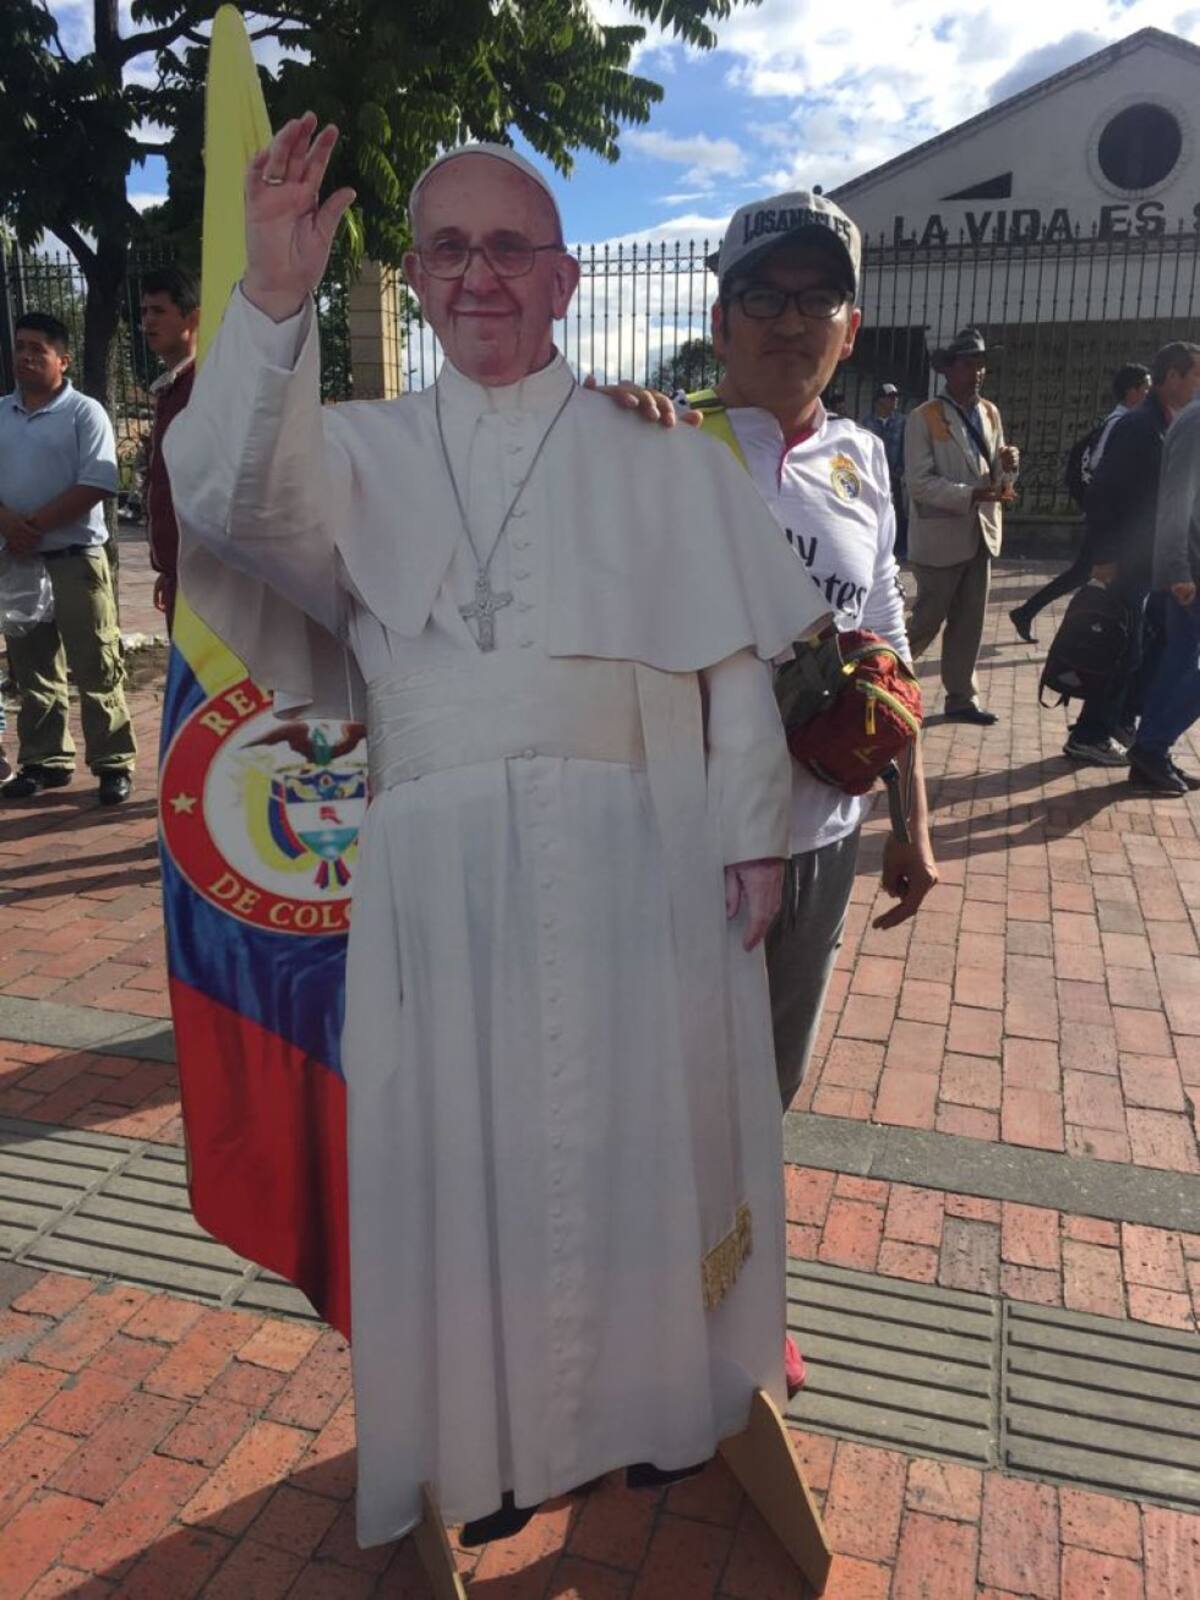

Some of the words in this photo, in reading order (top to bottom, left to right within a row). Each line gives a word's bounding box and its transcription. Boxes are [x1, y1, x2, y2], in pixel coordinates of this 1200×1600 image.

[894, 214, 948, 248] LA
[964, 208, 1073, 245] VIDA
[1101, 201, 1166, 239] ES
[200, 688, 272, 736] RE
[208, 872, 261, 914] DE
